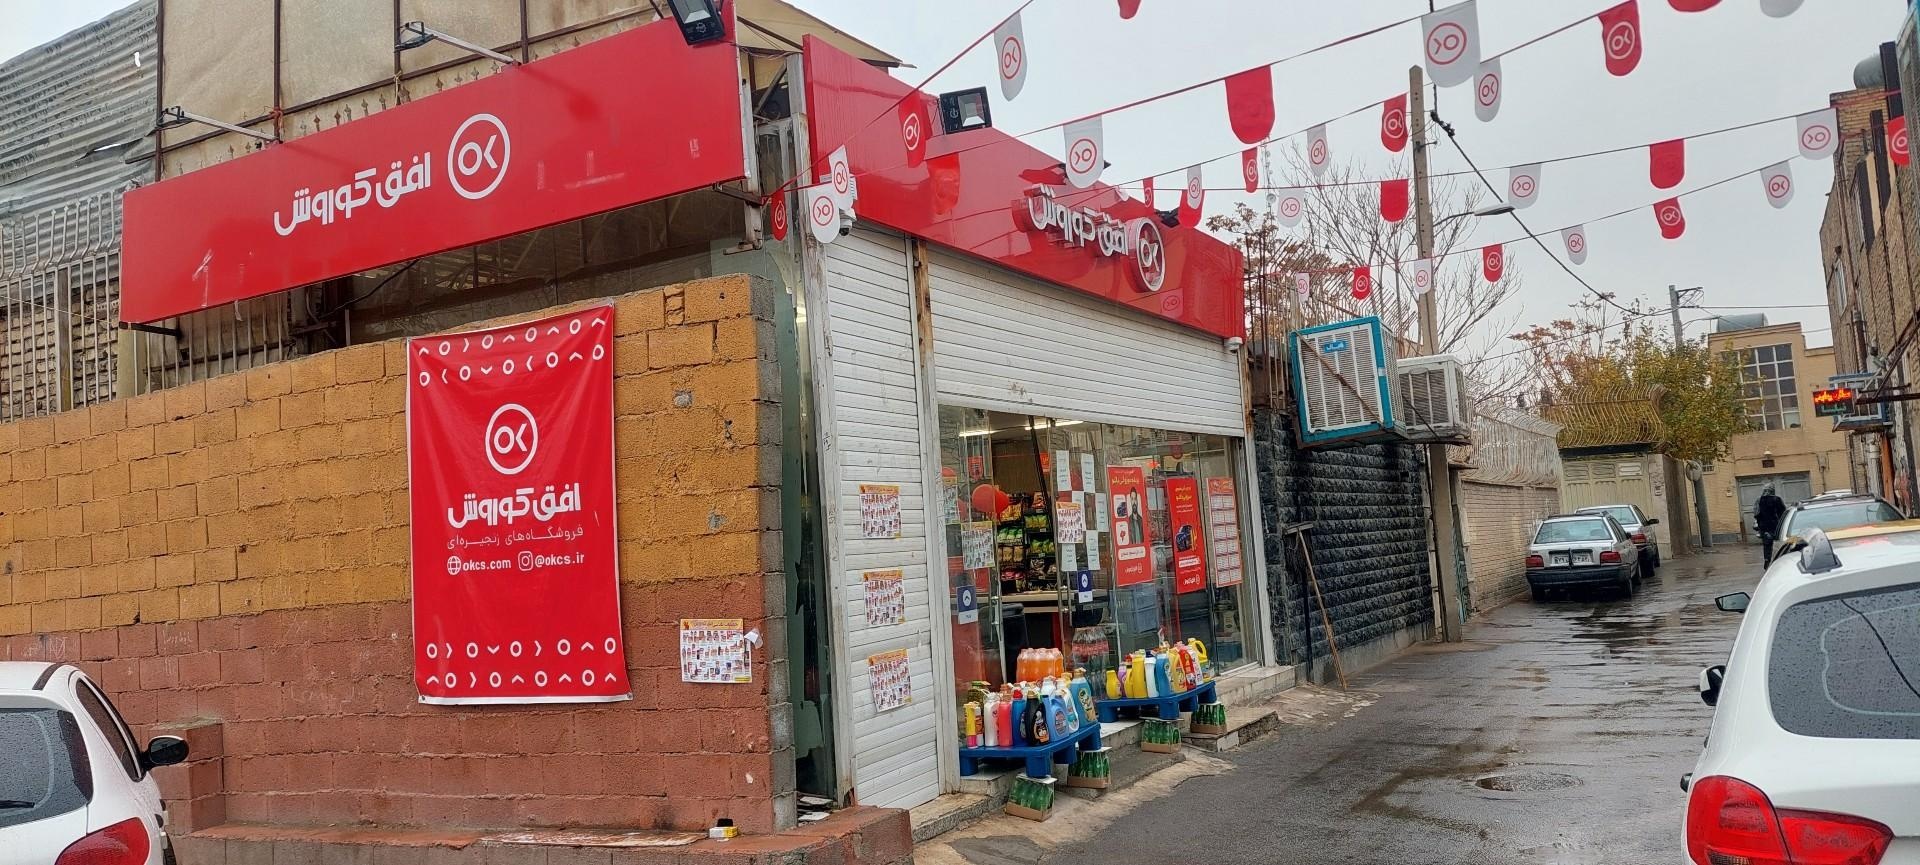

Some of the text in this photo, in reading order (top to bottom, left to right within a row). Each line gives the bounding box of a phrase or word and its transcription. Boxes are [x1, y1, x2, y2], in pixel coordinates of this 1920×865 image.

[273, 151, 431, 236] افق کوروش
[1026, 183, 1128, 257] افق کوروش
[447, 482, 582, 529] افق کوروش
[462, 557, 512, 572] okcs.com
[534, 551, 585, 569] @okcs.ir
